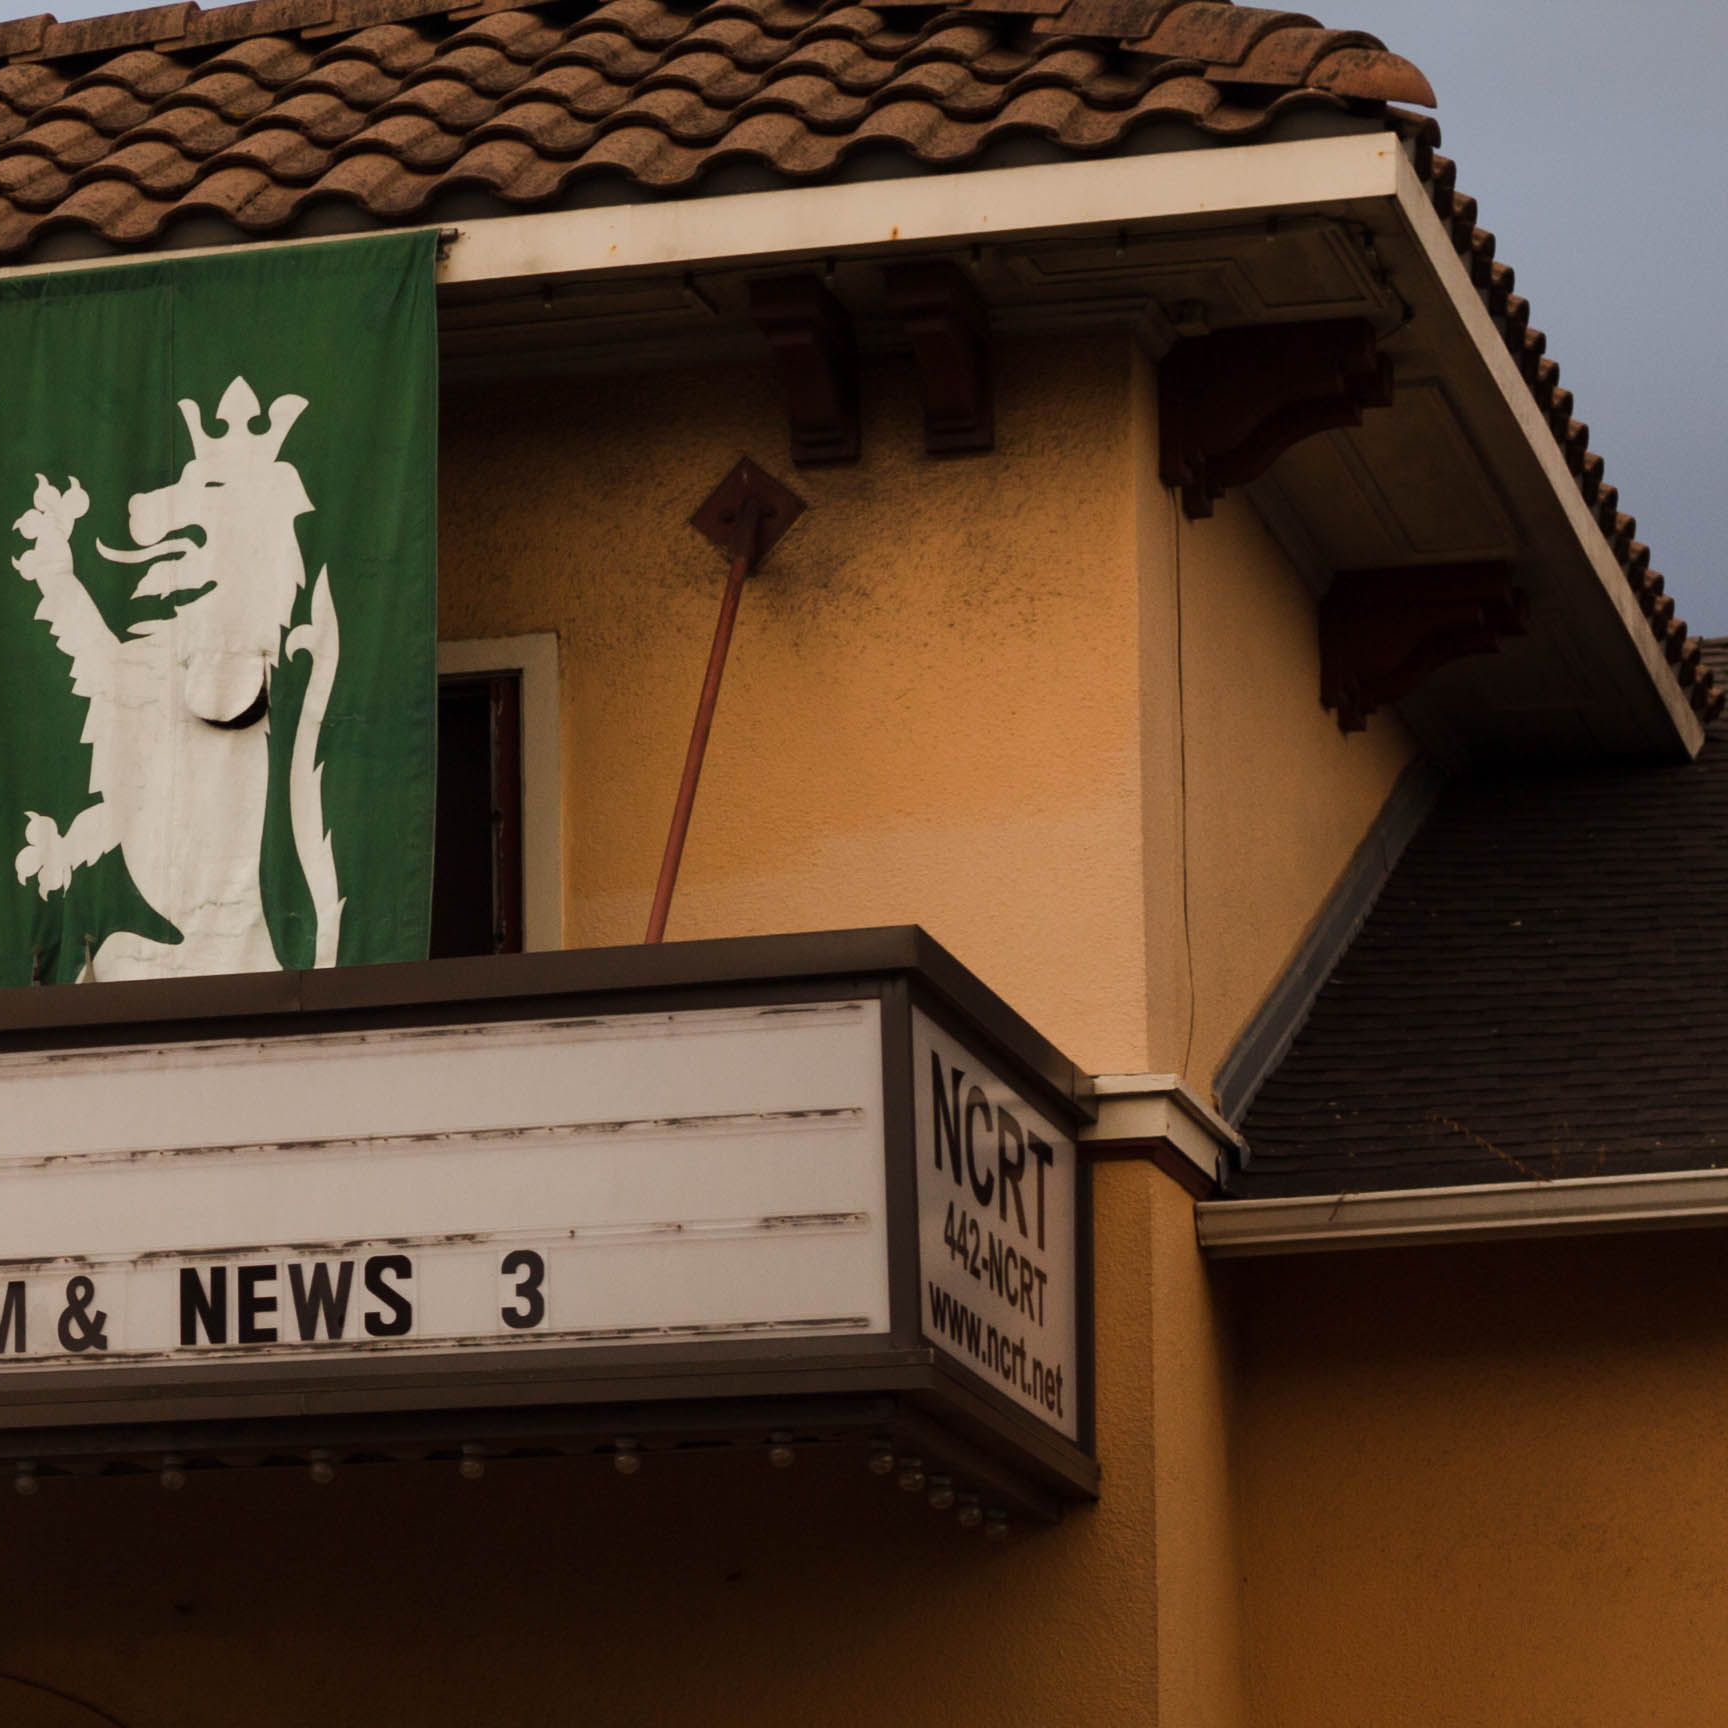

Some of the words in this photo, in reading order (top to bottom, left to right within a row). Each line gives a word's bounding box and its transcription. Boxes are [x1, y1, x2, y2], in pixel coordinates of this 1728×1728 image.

[931, 1050, 1054, 1252] NCRT
[56, 1275, 109, 1353] &
[179, 1254, 414, 1346] NEWS
[500, 1248, 546, 1330] 3
[944, 1201, 1048, 1328] 442-NCRT
[928, 1280, 1064, 1419] www.ncrt.net
